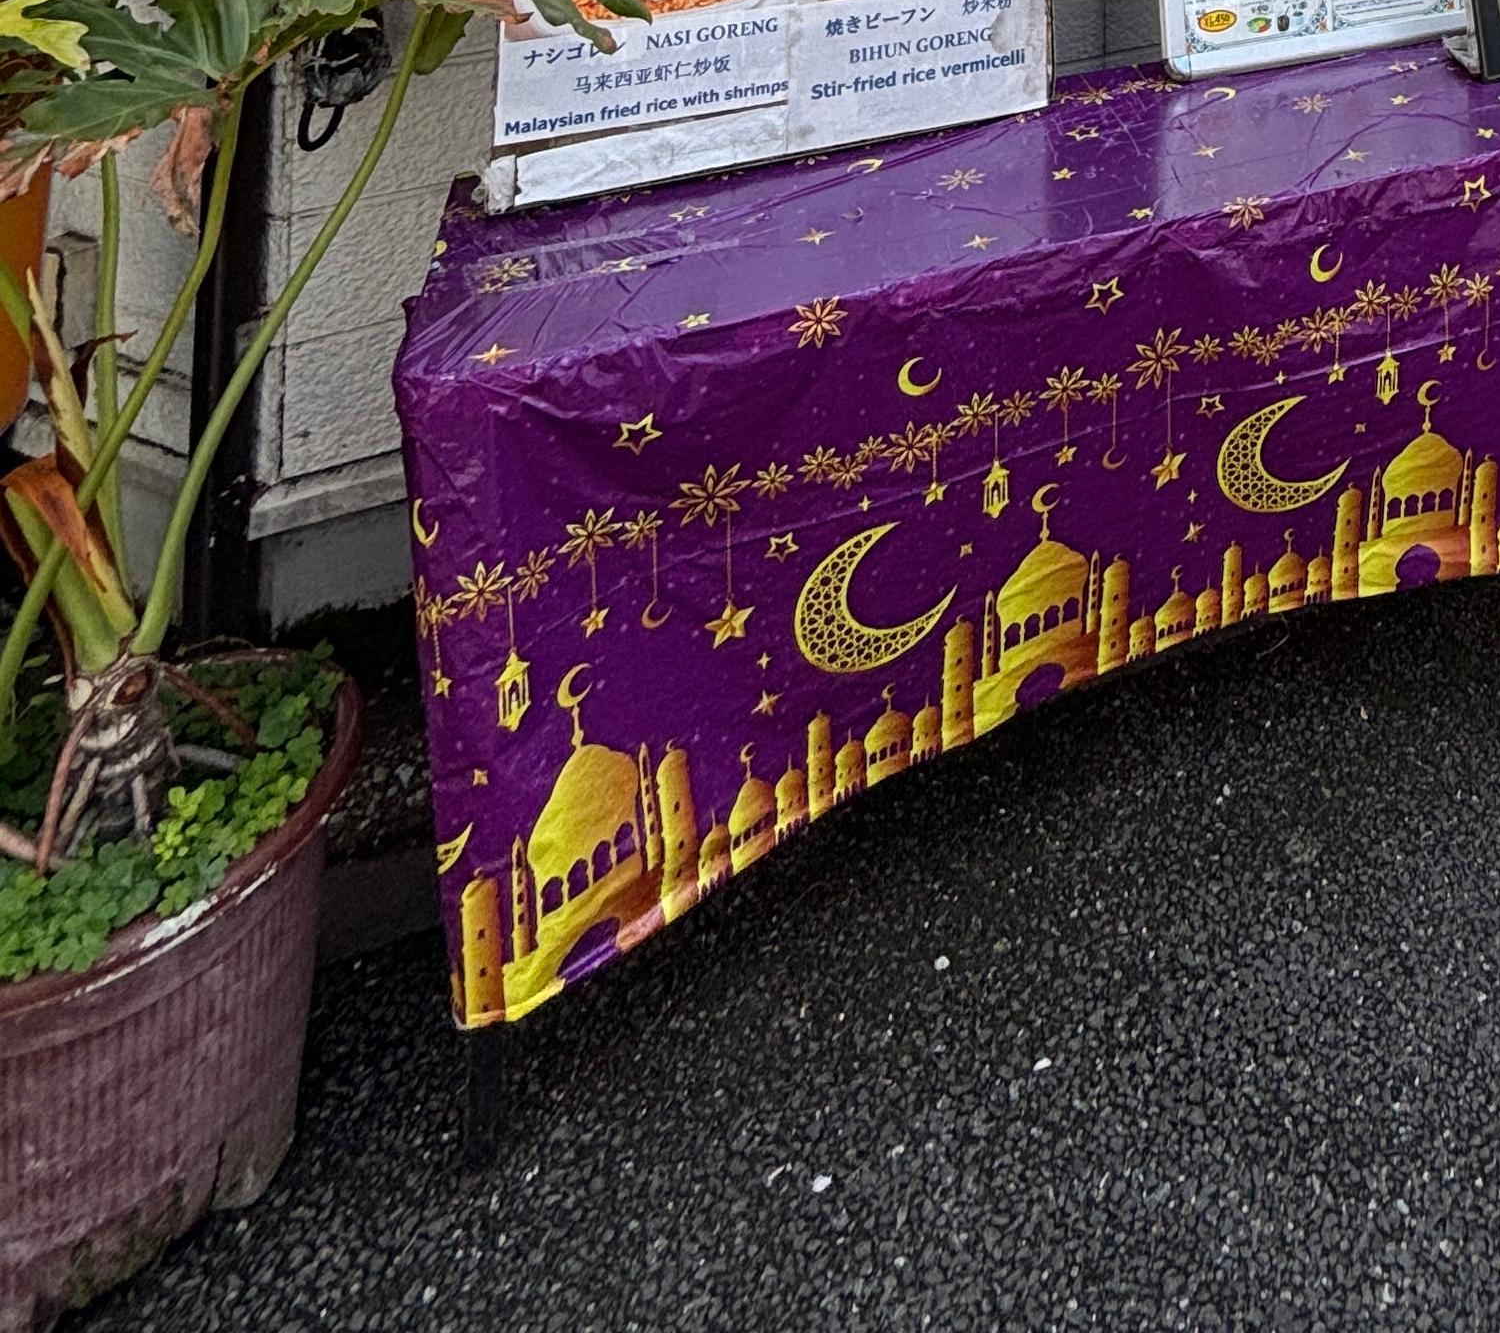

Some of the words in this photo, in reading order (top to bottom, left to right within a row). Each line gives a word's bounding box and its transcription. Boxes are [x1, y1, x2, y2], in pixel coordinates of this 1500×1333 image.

[523, 41, 626, 69] ナシゴレ
[645, 29, 693, 51] NASI
[696, 17, 779, 44] GORENG
[824, 5, 937, 37] 焼きビーフン
[848, 39, 911, 65] BIHUN
[915, 25, 993, 53] GORENG
[573, 54, 731, 95] 马来西亚虾仁炒饭
[810, 72, 898, 101] Stir-fried
[901, 65, 936, 85] rice
[939, 49, 1026, 78] vermicelli
[504, 109, 595, 136] Malaysian
[600, 102, 641, 121] fried
[645, 96, 678, 114] rice
[682, 89, 721, 107] with
[724, 78, 790, 104] shrimps
